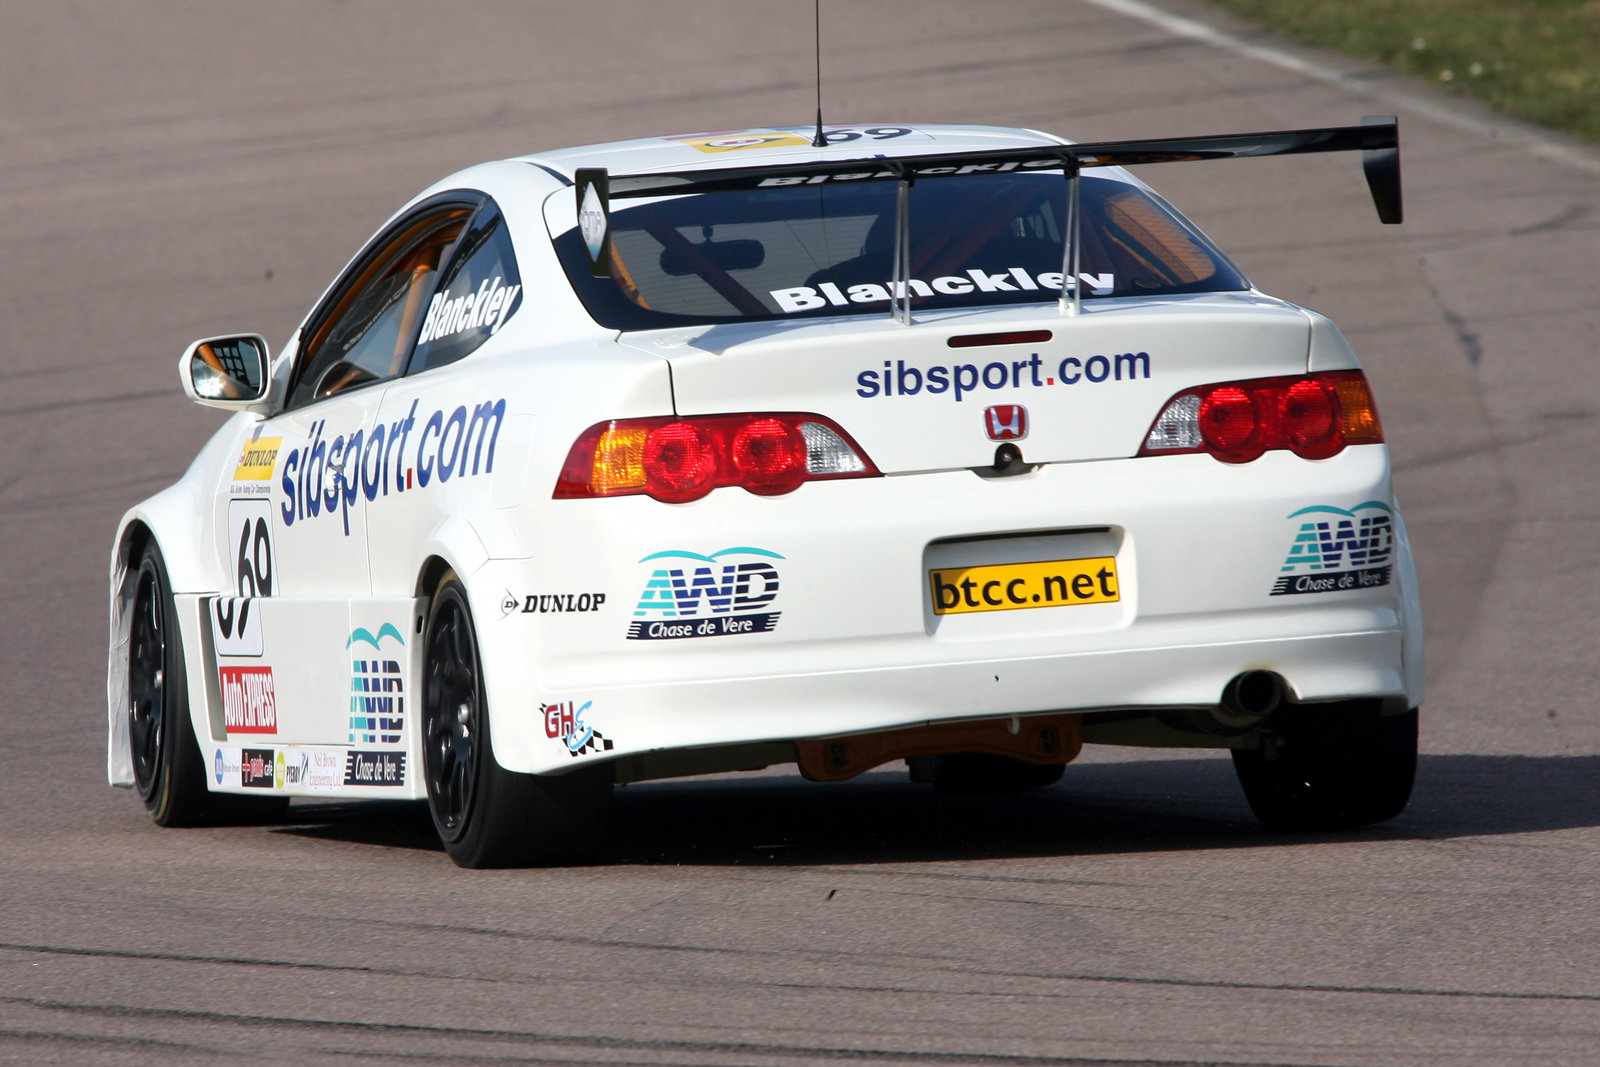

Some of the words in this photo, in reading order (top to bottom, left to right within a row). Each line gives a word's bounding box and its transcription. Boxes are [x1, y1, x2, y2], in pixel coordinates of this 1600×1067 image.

[418, 276, 521, 345] Blanckley
[769, 267, 1115, 314] Blanckley
[856, 351, 1151, 402] sibsport.com
[243, 449, 278, 467] DUNLOP
[281, 397, 507, 537] sibsport.com
[1281, 515, 1392, 572] AWD
[521, 593, 606, 614] DUNLOP
[633, 562, 780, 617] AWD
[933, 565, 1117, 610] btcc.net
[1295, 575, 1336, 592] Chase
[1338, 572, 1354, 588] de
[1358, 570, 1381, 586] Vere
[648, 618, 693, 638] Chase
[697, 619, 716, 635] de
[721, 617, 753, 633] Vere
[348, 660, 404, 744] AWD
[355, 754, 374, 781] Chase
[374, 755, 383, 779] de
[384, 755, 397, 781] Vere
